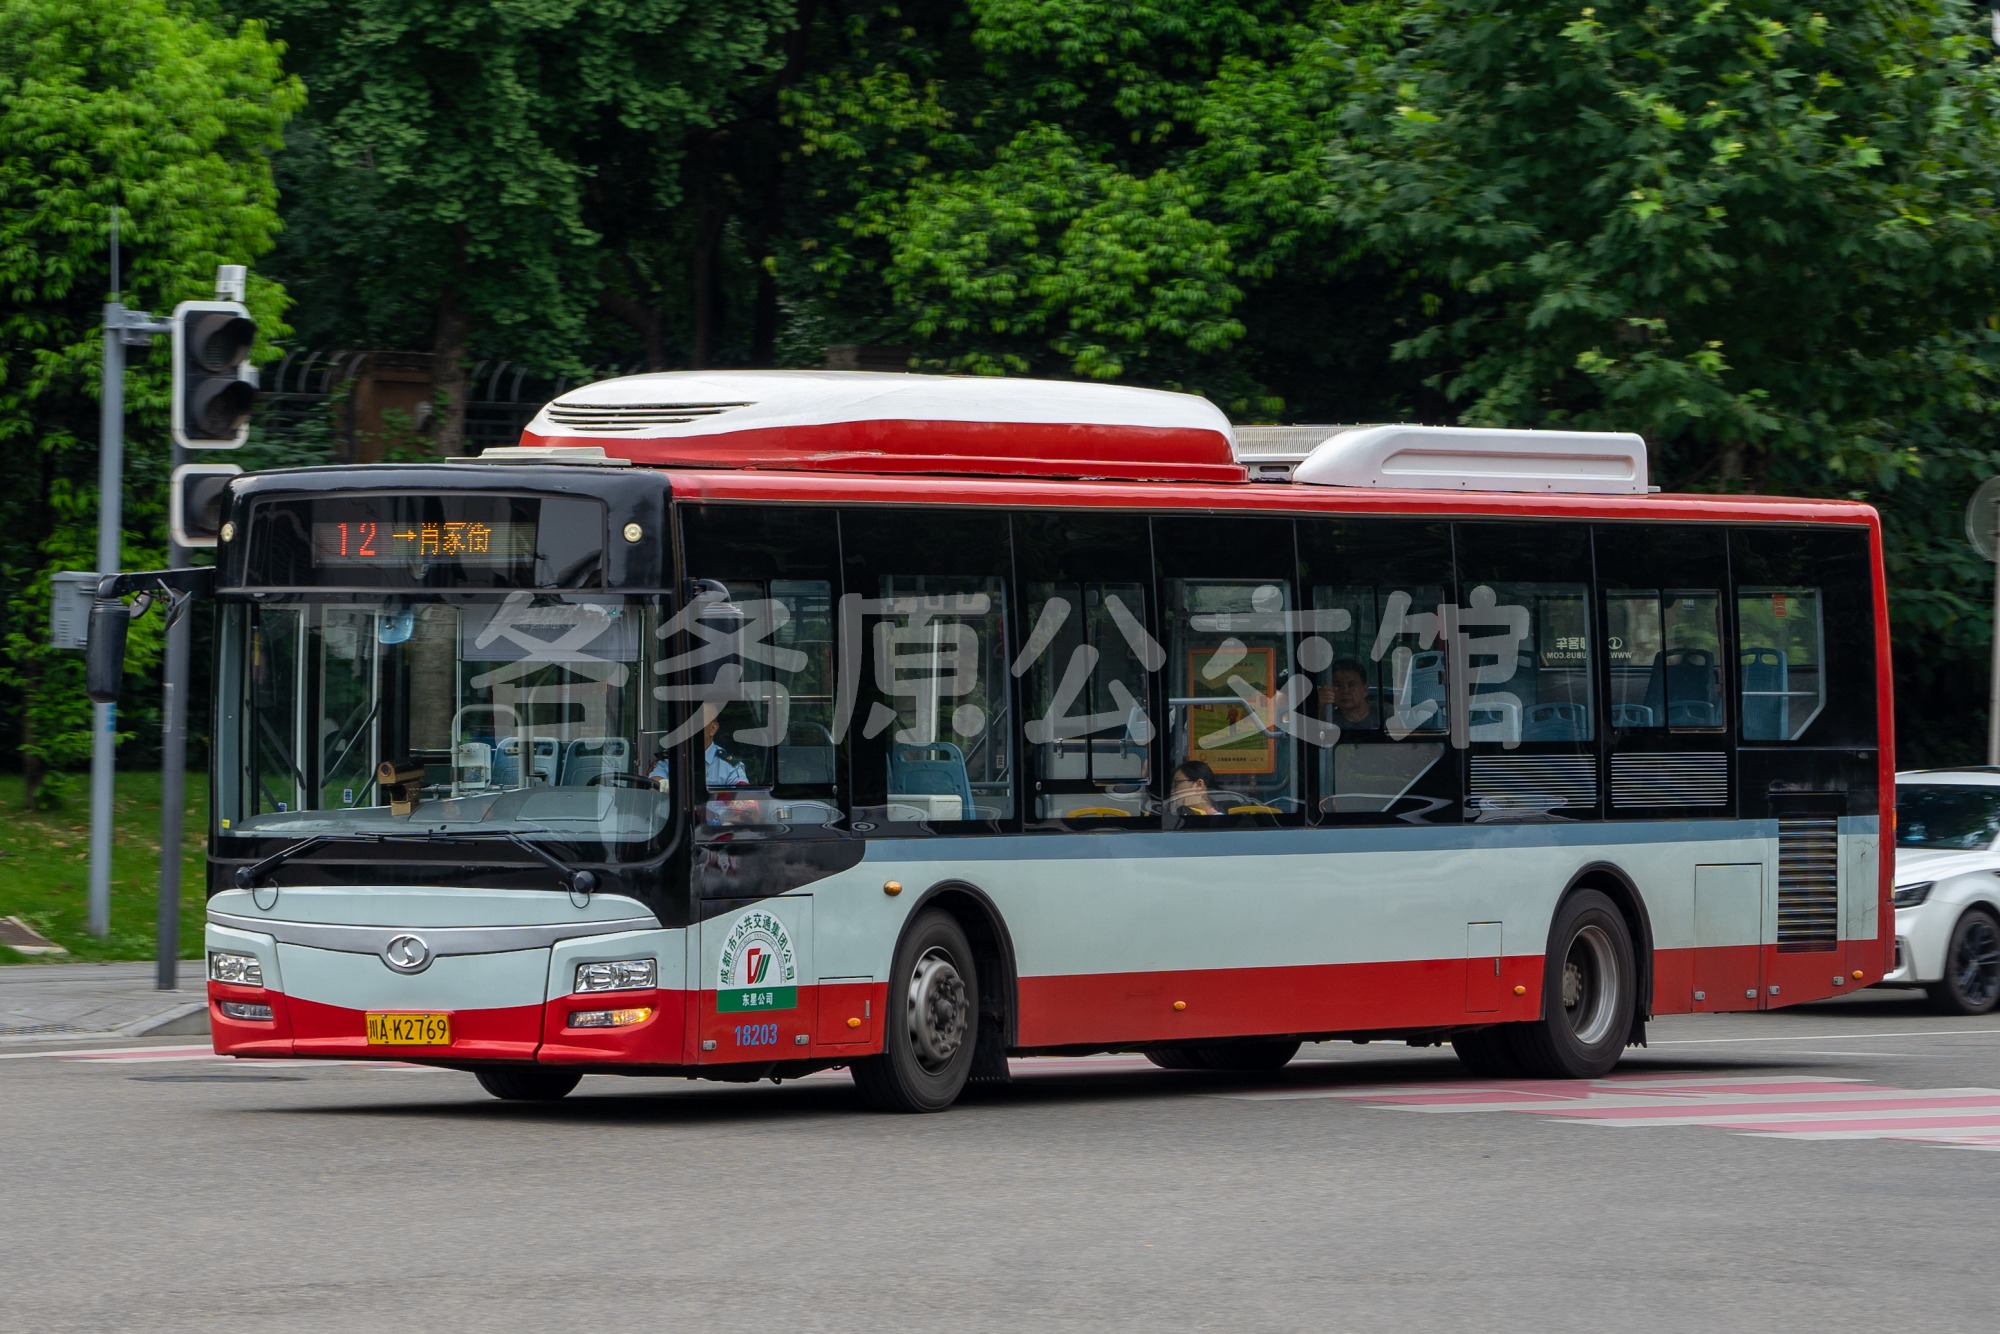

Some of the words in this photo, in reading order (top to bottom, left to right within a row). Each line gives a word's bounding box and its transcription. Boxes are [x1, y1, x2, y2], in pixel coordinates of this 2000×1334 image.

[337, 523, 376, 556] 12
[720, 913, 795, 984] 成都市公共交通集团公司
[742, 992, 774, 1006] 东星公司
[735, 1024, 778, 1046] 18203
